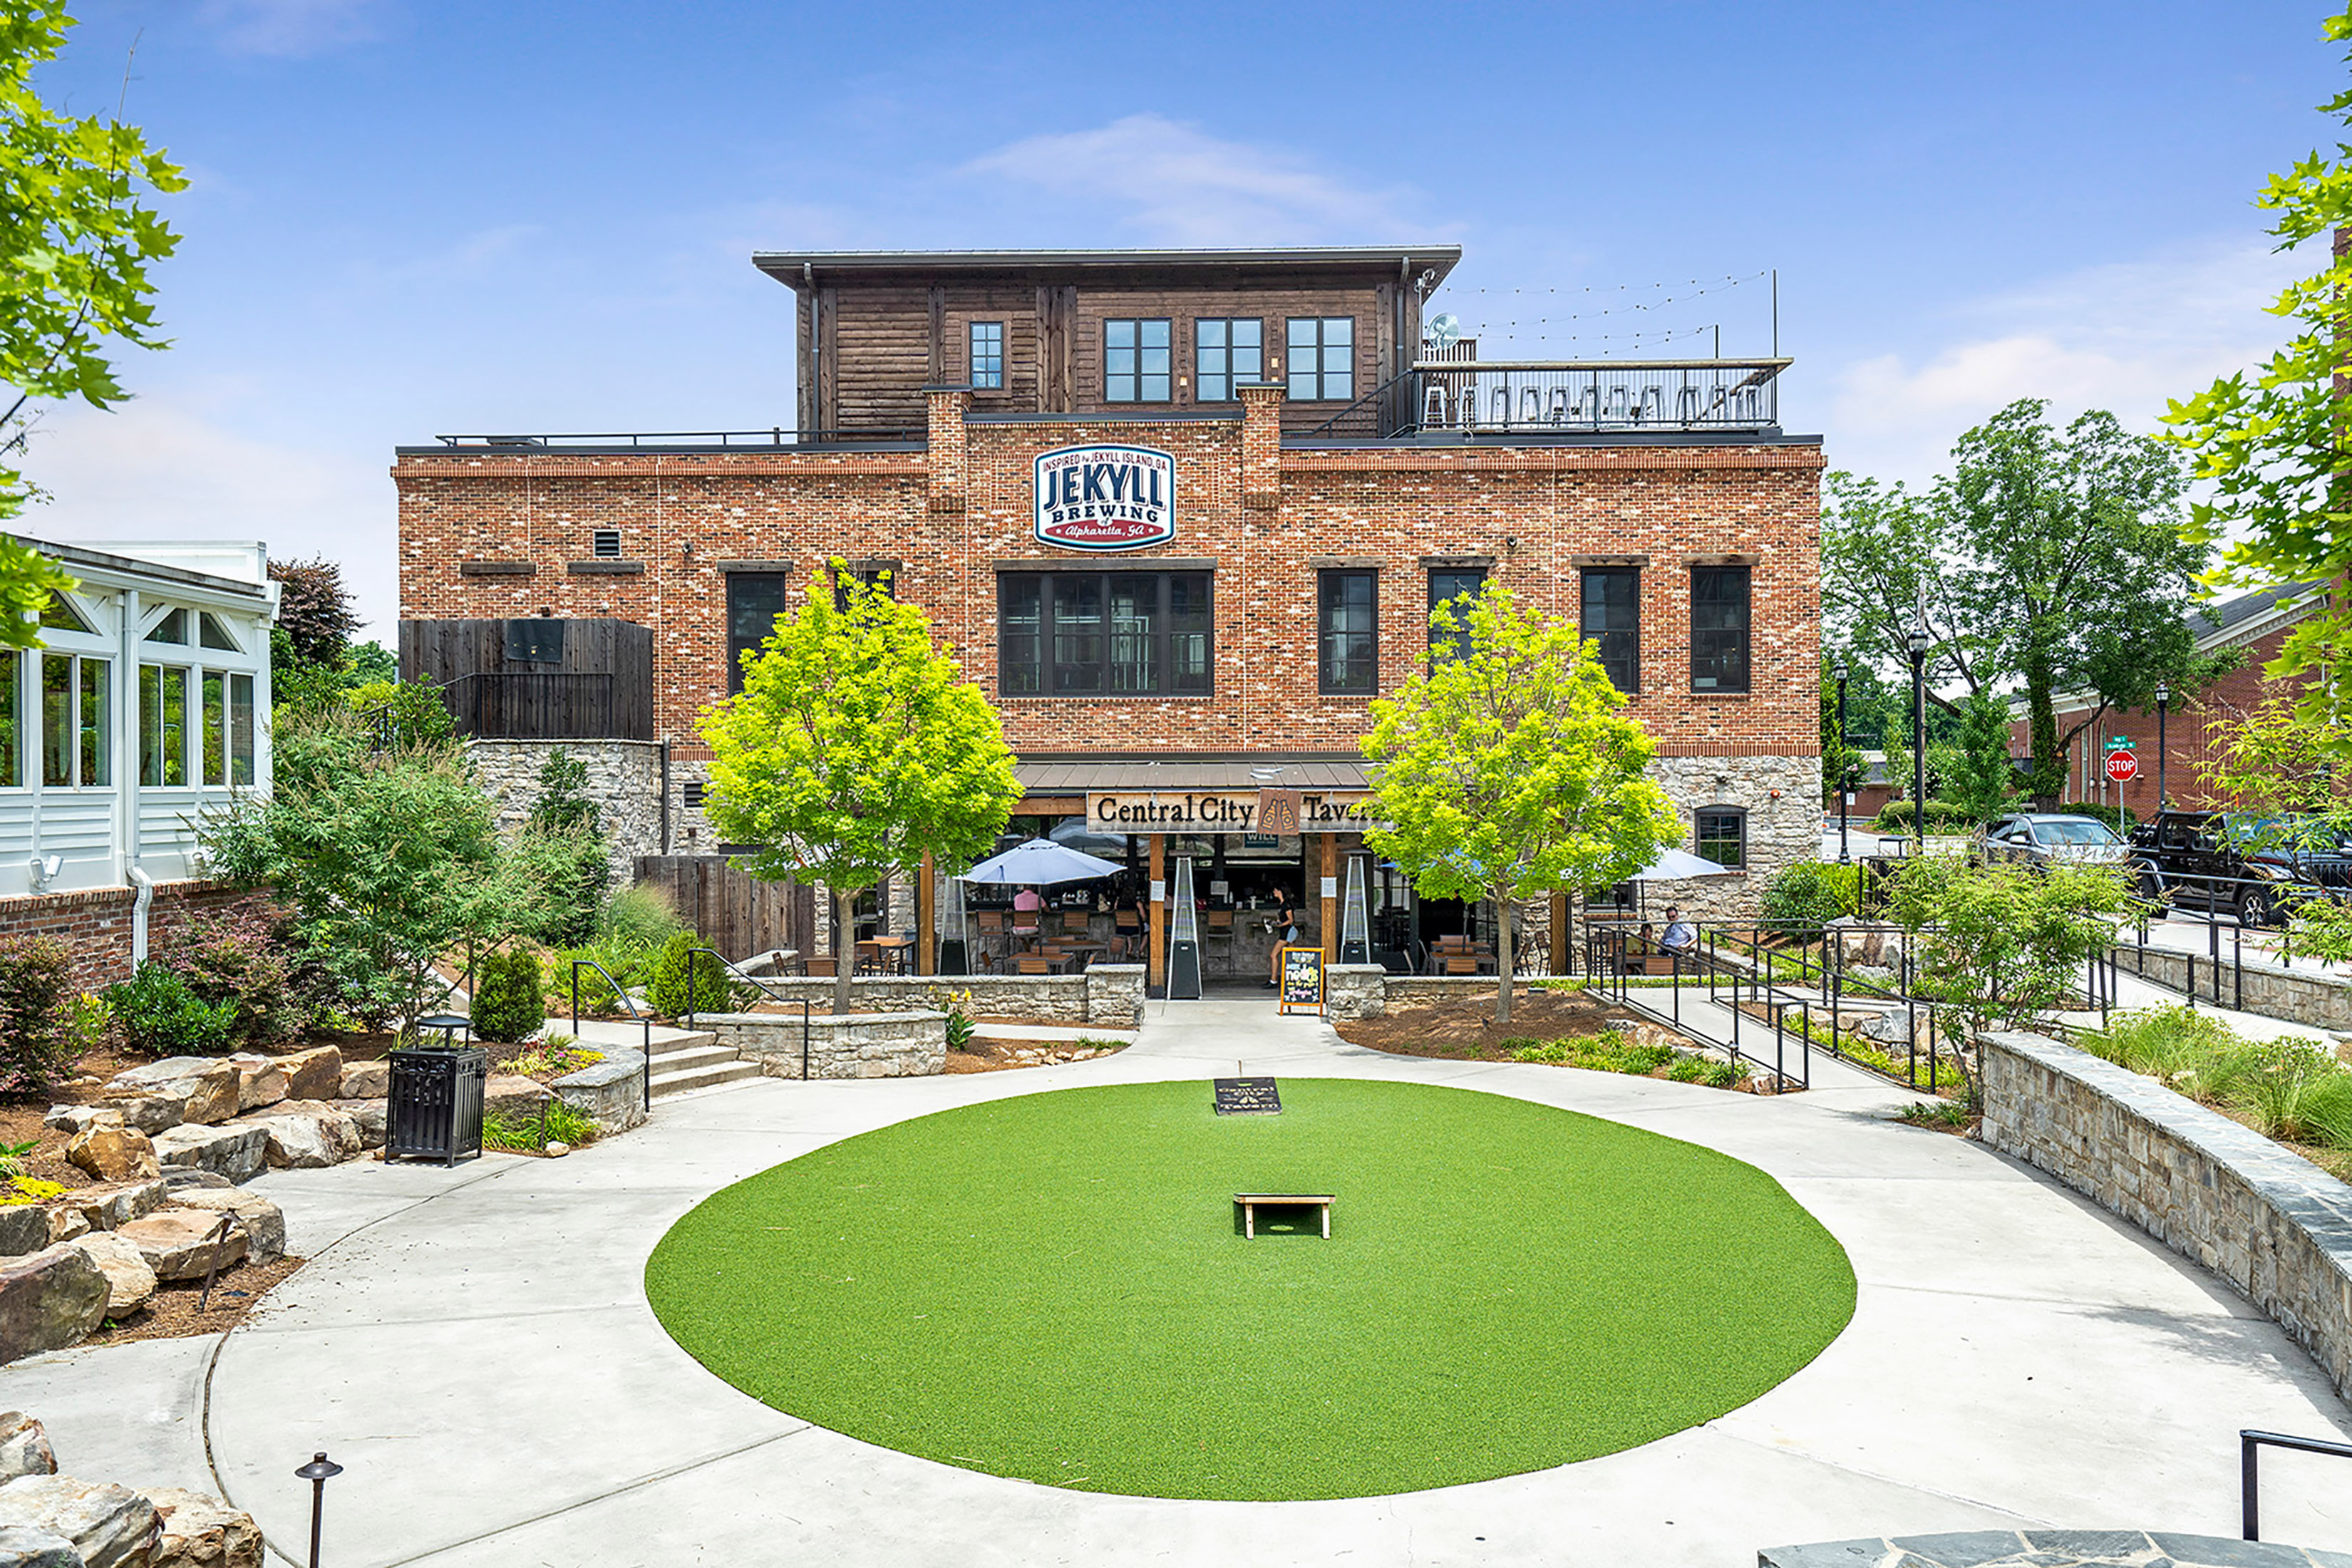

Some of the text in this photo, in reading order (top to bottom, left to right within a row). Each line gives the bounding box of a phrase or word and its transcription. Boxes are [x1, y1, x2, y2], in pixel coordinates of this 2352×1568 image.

[1043, 454, 1080, 472] INSPIRED
[1090, 452, 1120, 463] JEKYLL
[1156, 458, 1167, 470] GA
[1043, 464, 1164, 510] JEKYLL
[1052, 505, 1158, 523] BREWING
[1127, 525, 1144, 537] GA
[2108, 760, 2135, 772] STOP
[1098, 795, 1195, 822] Central
[1200, 796, 1254, 828] City
